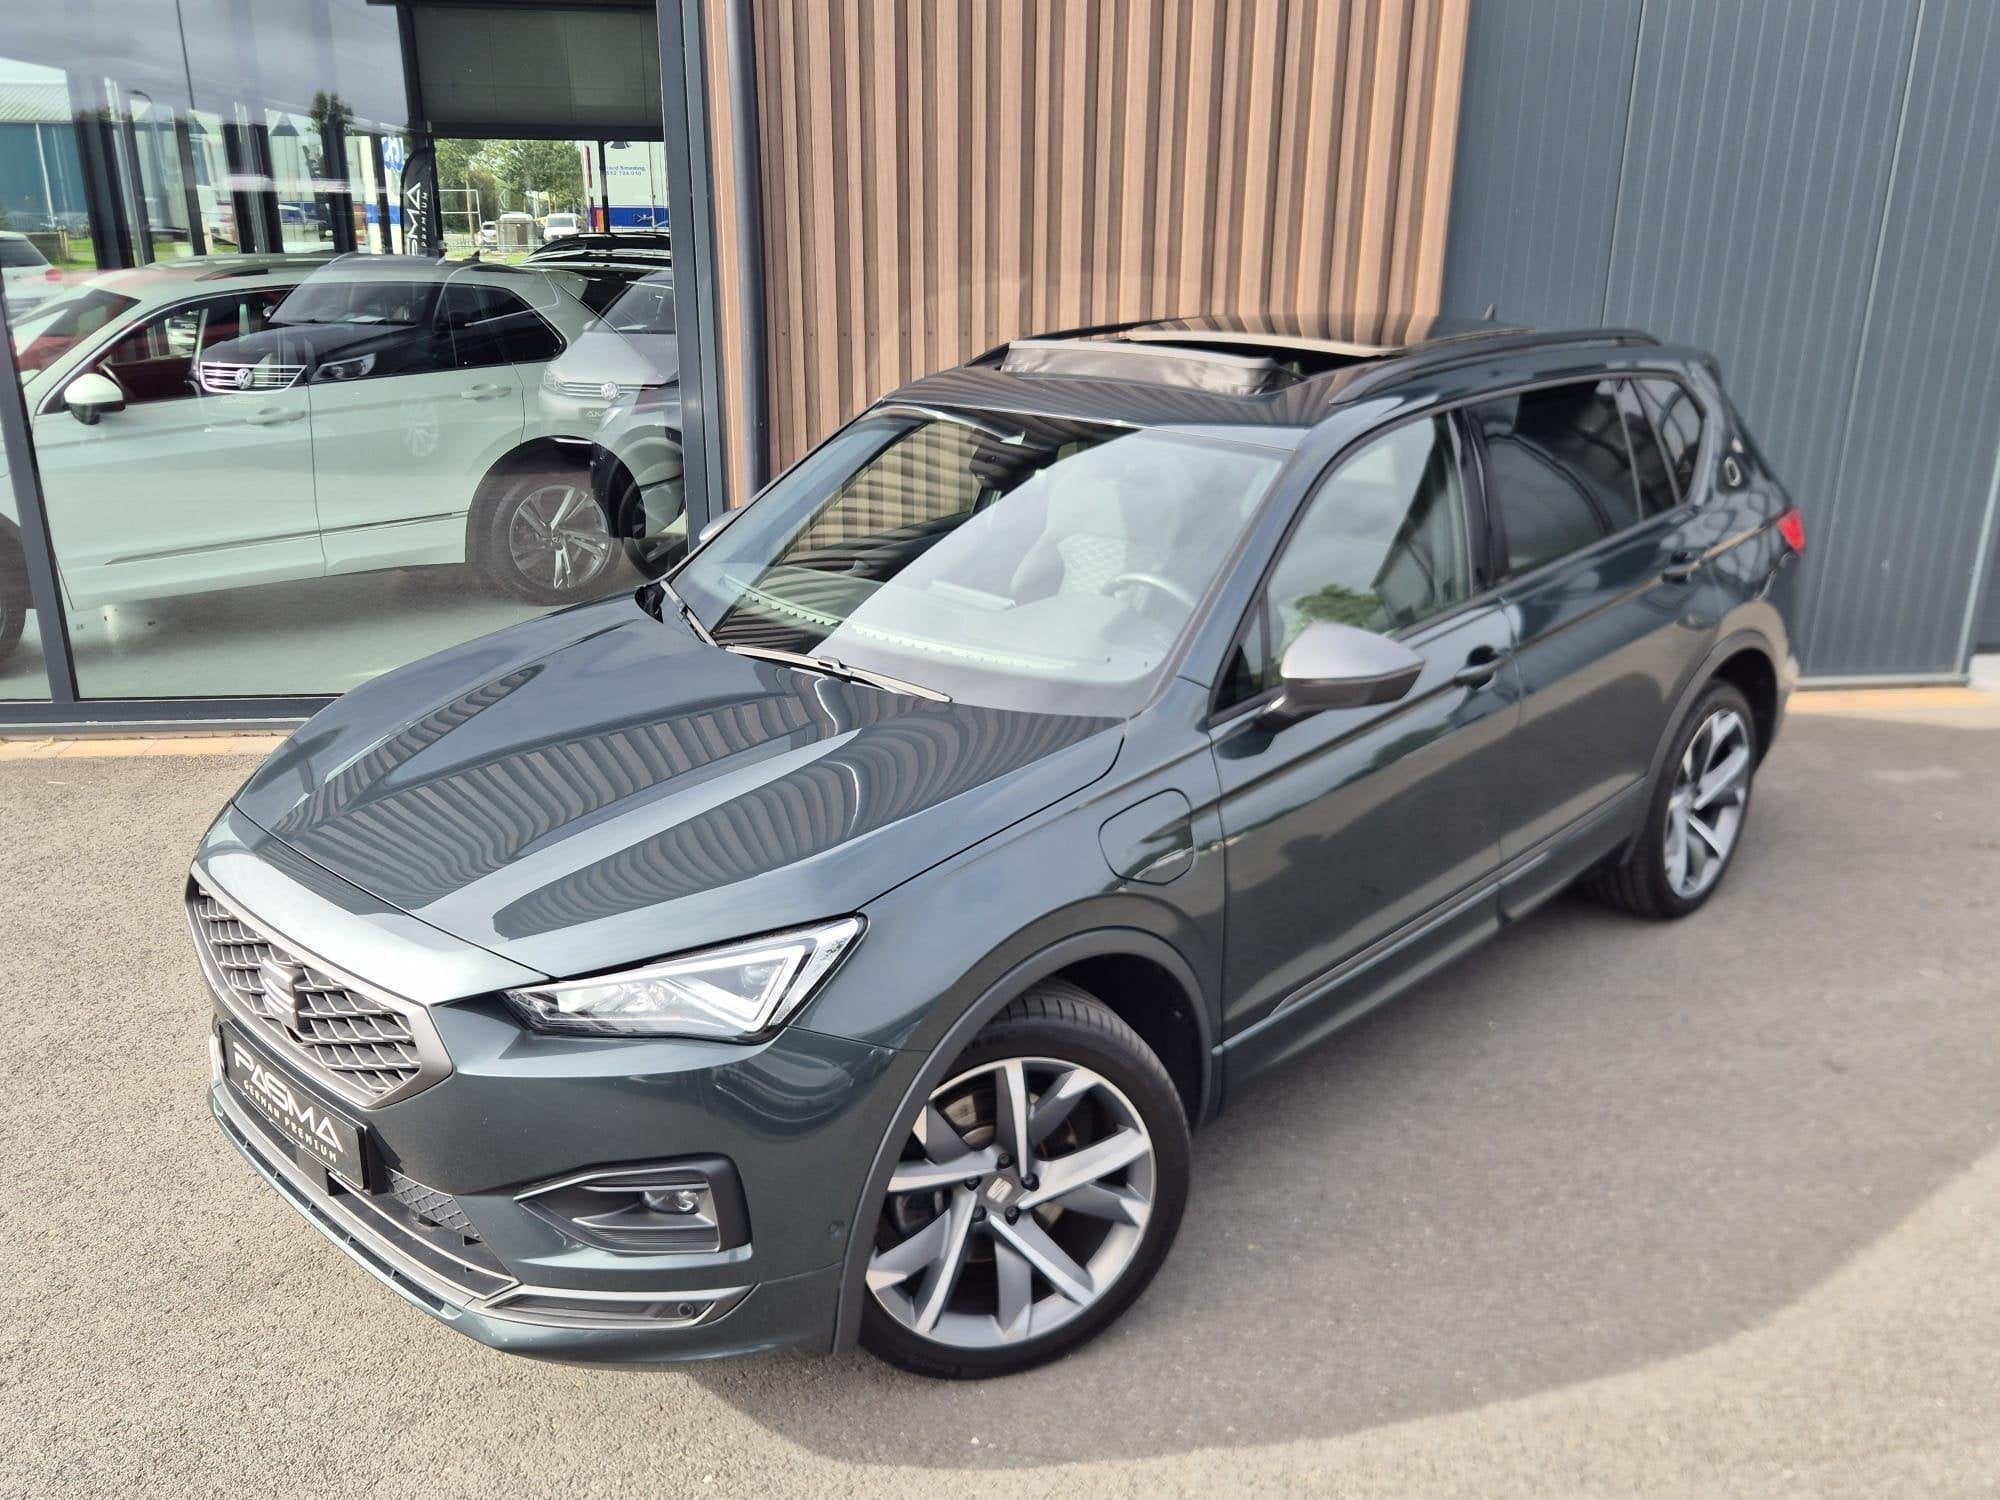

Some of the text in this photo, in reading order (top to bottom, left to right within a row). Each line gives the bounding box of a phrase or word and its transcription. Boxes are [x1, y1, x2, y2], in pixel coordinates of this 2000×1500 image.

[406, 182, 421, 256] SMA
[232, 1041, 344, 1153] PASMA
[243, 1079, 337, 1163] GERMAN PREMIUM
